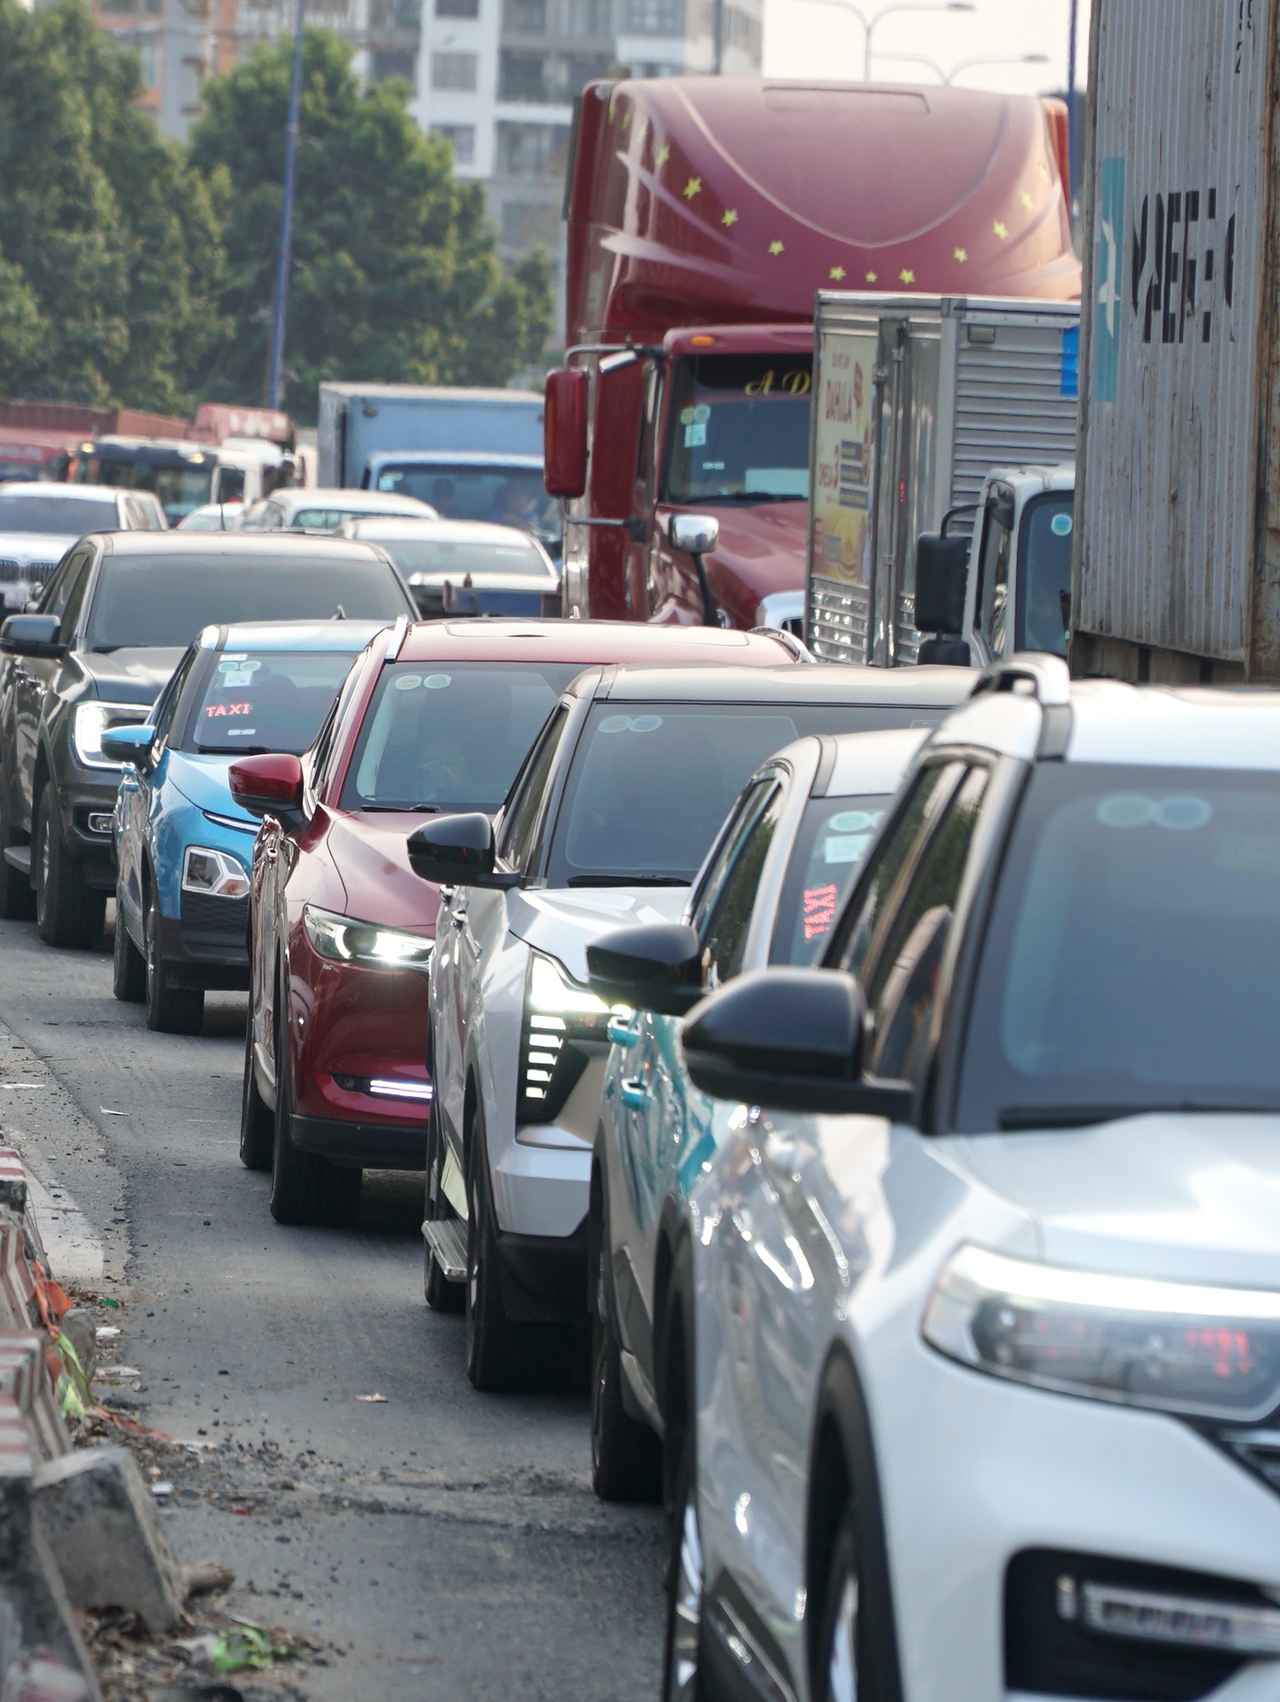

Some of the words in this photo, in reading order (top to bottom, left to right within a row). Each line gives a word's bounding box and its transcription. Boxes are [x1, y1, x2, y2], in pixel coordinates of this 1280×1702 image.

[744, 370, 774, 396] A
[205, 702, 250, 717] TAXI
[803, 884, 837, 940] TAXI
